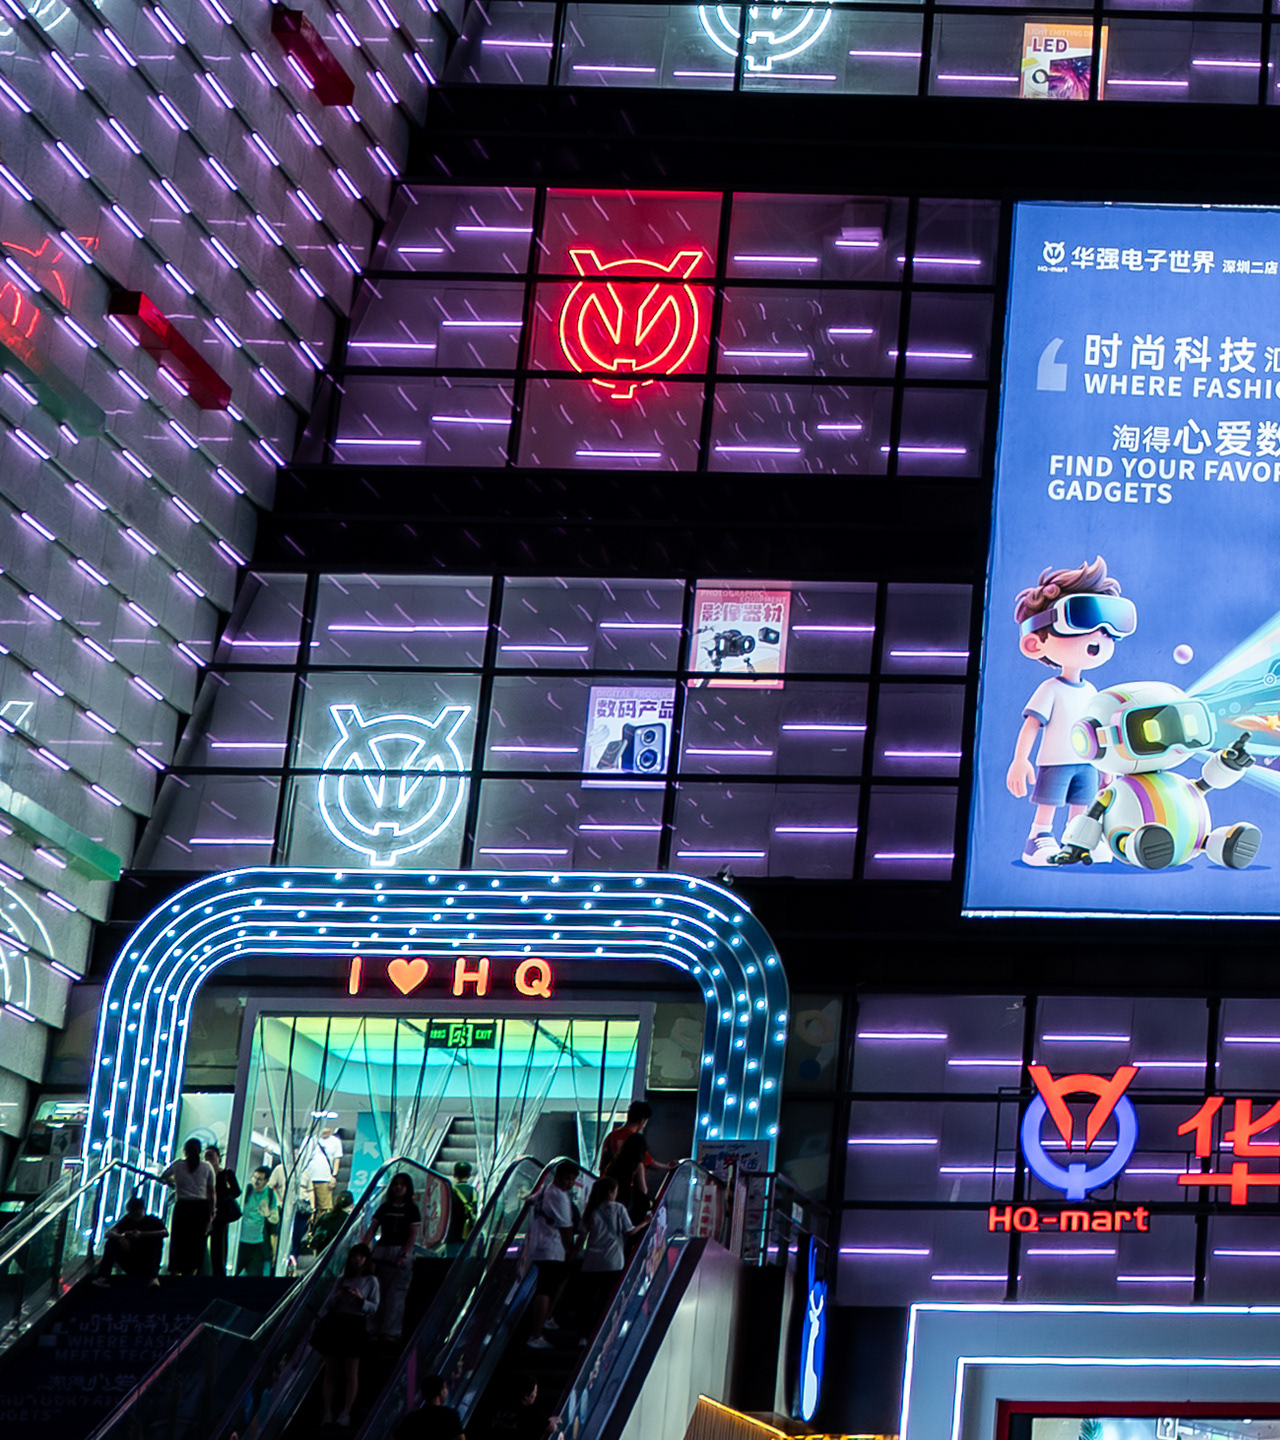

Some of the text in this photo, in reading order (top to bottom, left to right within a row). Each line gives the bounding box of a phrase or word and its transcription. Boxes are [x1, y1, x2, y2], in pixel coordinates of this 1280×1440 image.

[1032, 38, 1069, 53] LED
[1071, 246, 1279, 275] 华强电子世界 深圳二店
[1084, 373, 1183, 398] WHERE
[1049, 455, 1114, 478] FIND
[1120, 457, 1195, 481] YOUR
[1047, 479, 1173, 505] GADGETS
[701, 603, 784, 623] 影像器材
[596, 690, 631, 698] DIGITAL
[597, 699, 674, 719] 数码产品
[987, 1204, 1151, 1233] HQ-mart
